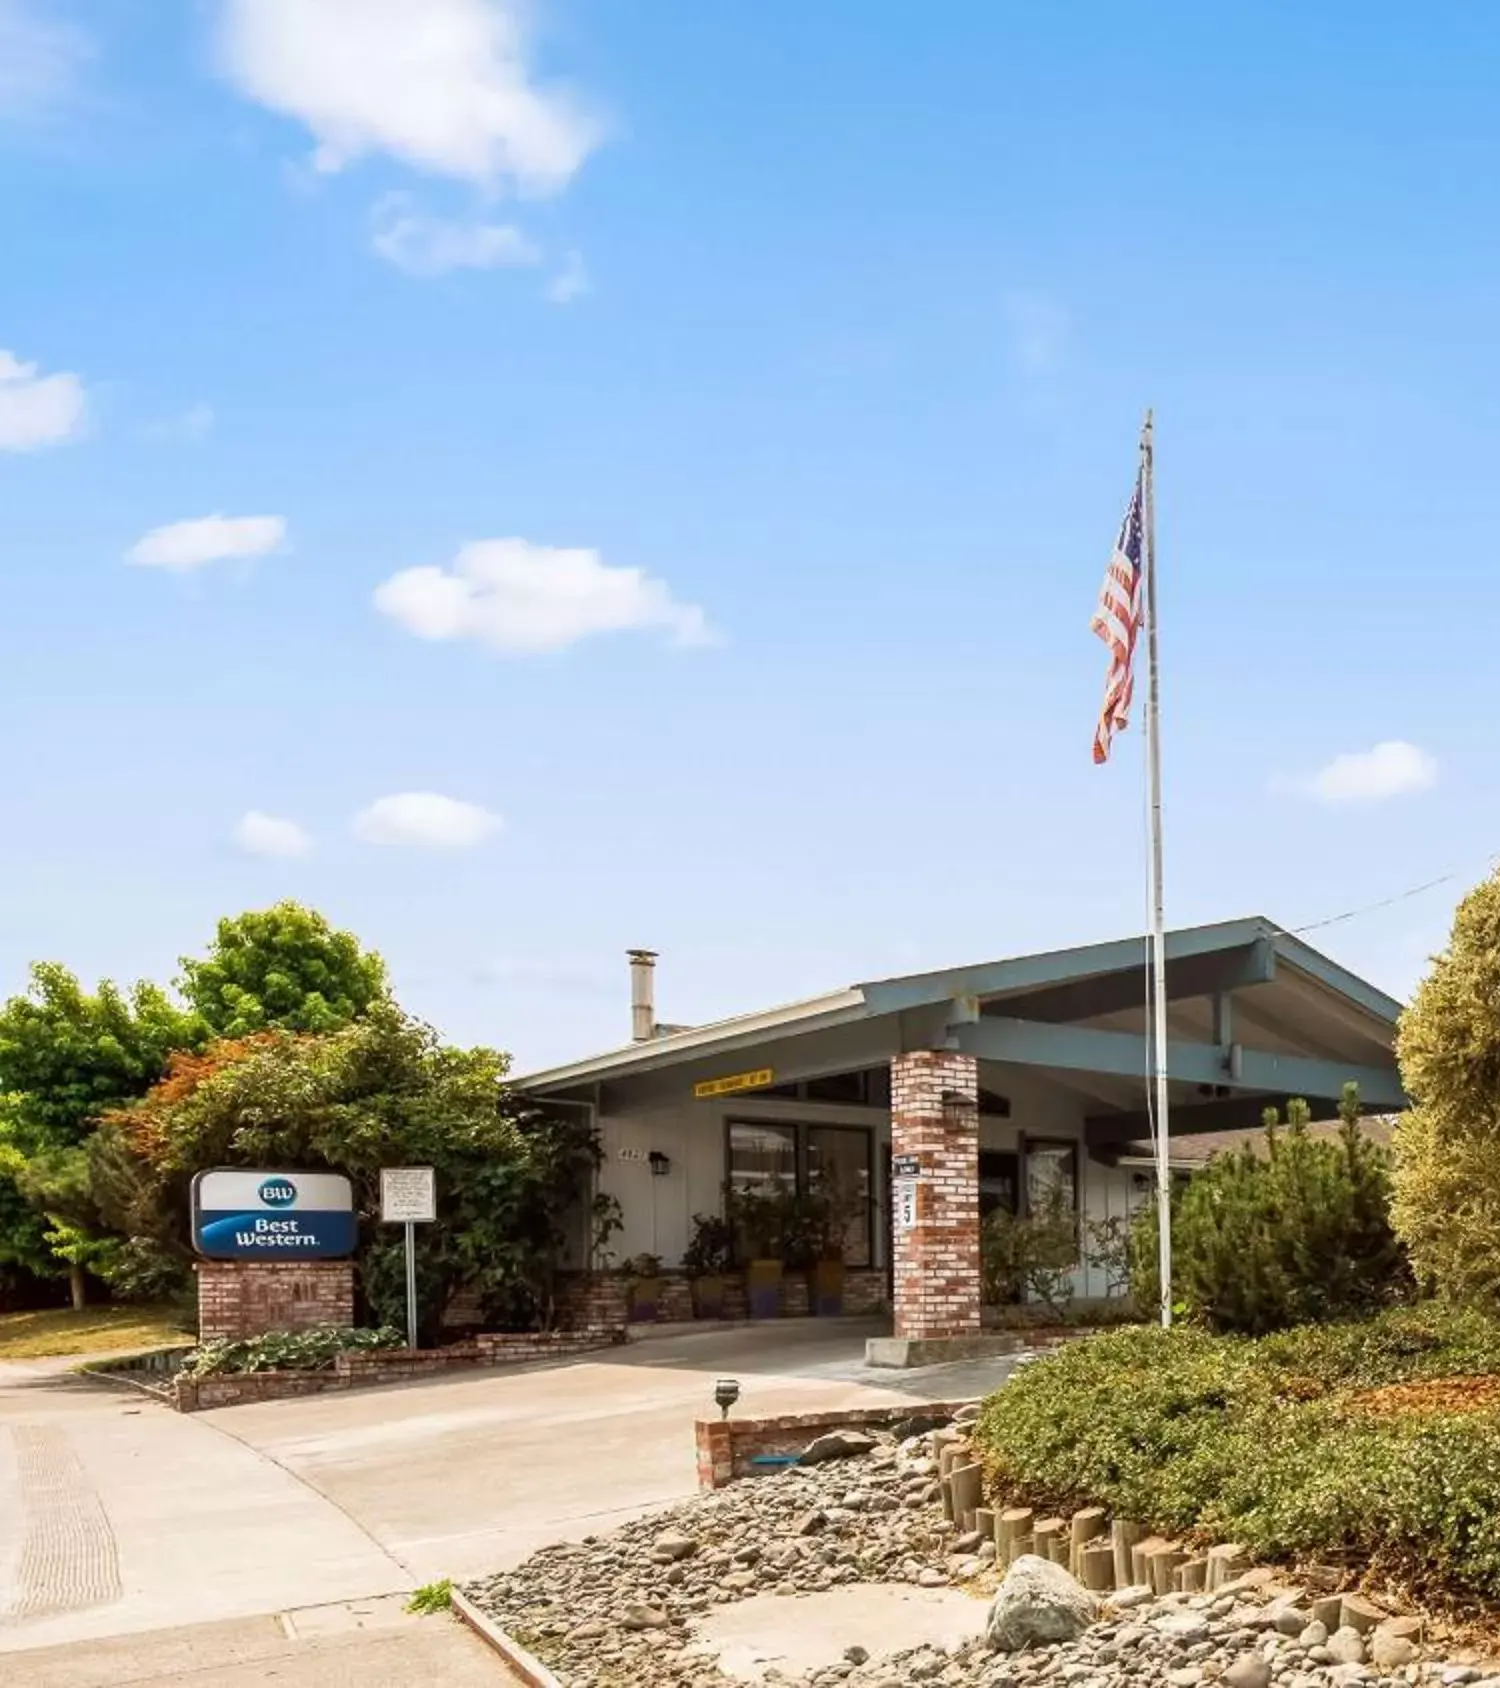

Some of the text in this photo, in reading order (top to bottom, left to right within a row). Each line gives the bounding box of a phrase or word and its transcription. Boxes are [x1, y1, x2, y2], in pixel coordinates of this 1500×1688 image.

[263, 1187, 293, 1199] BW
[255, 1218, 299, 1233] Best
[236, 1231, 316, 1247] Western
